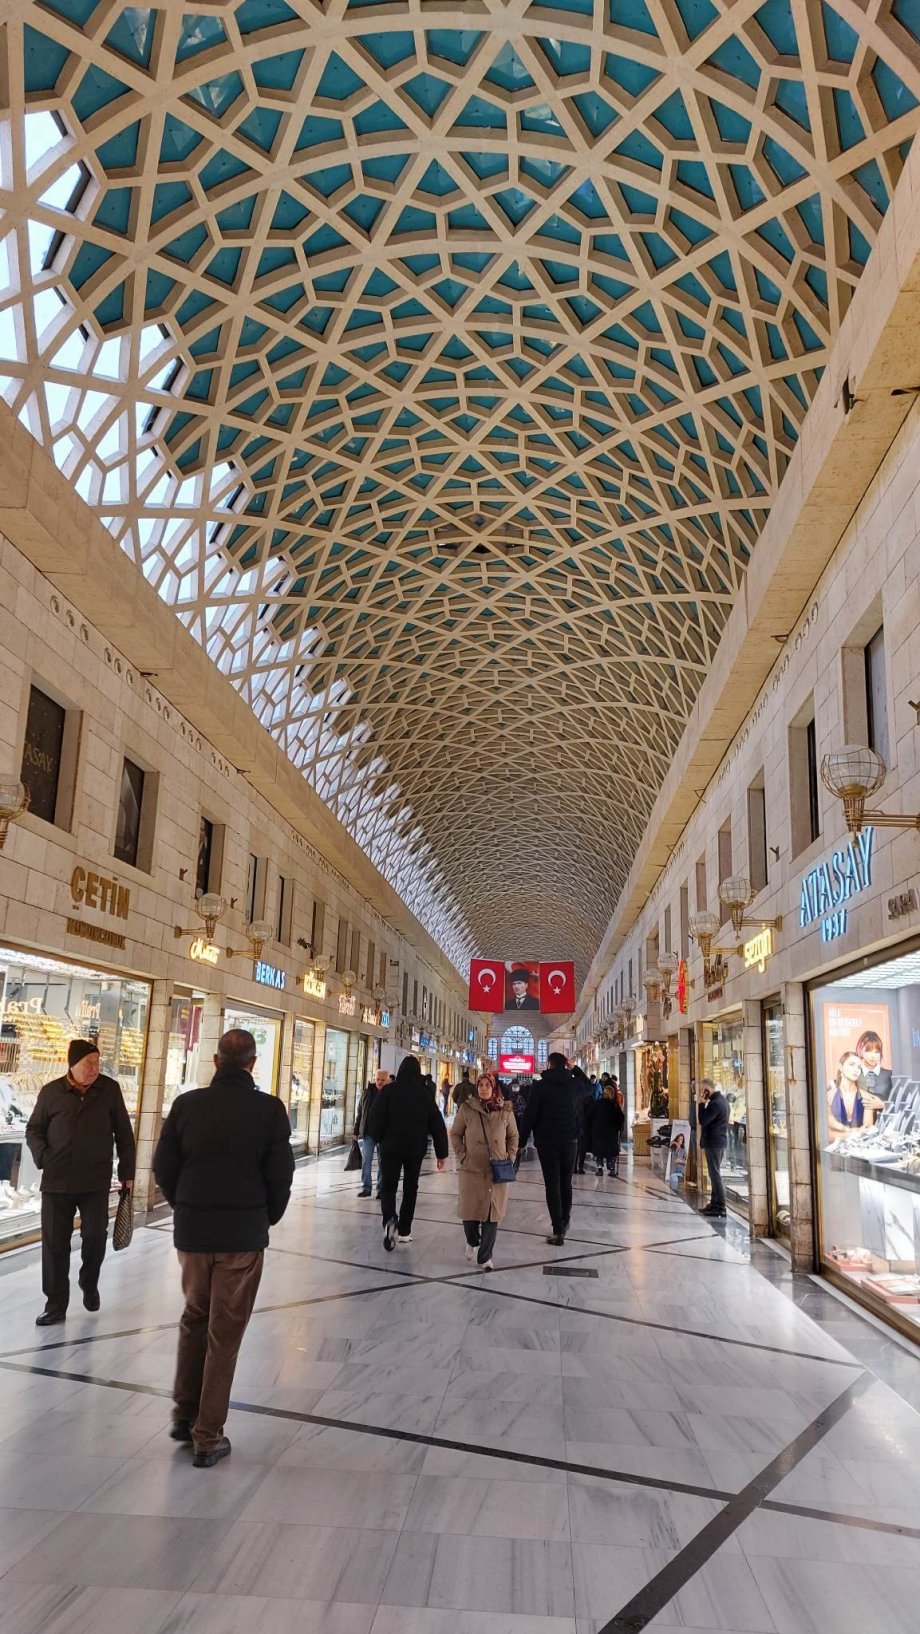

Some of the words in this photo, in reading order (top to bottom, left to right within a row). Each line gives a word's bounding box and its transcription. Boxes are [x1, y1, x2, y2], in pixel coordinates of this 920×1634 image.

[71, 865, 130, 920] ÇETİN
[800, 826, 873, 927] ATASAY
[821, 908, 848, 942] 1937
